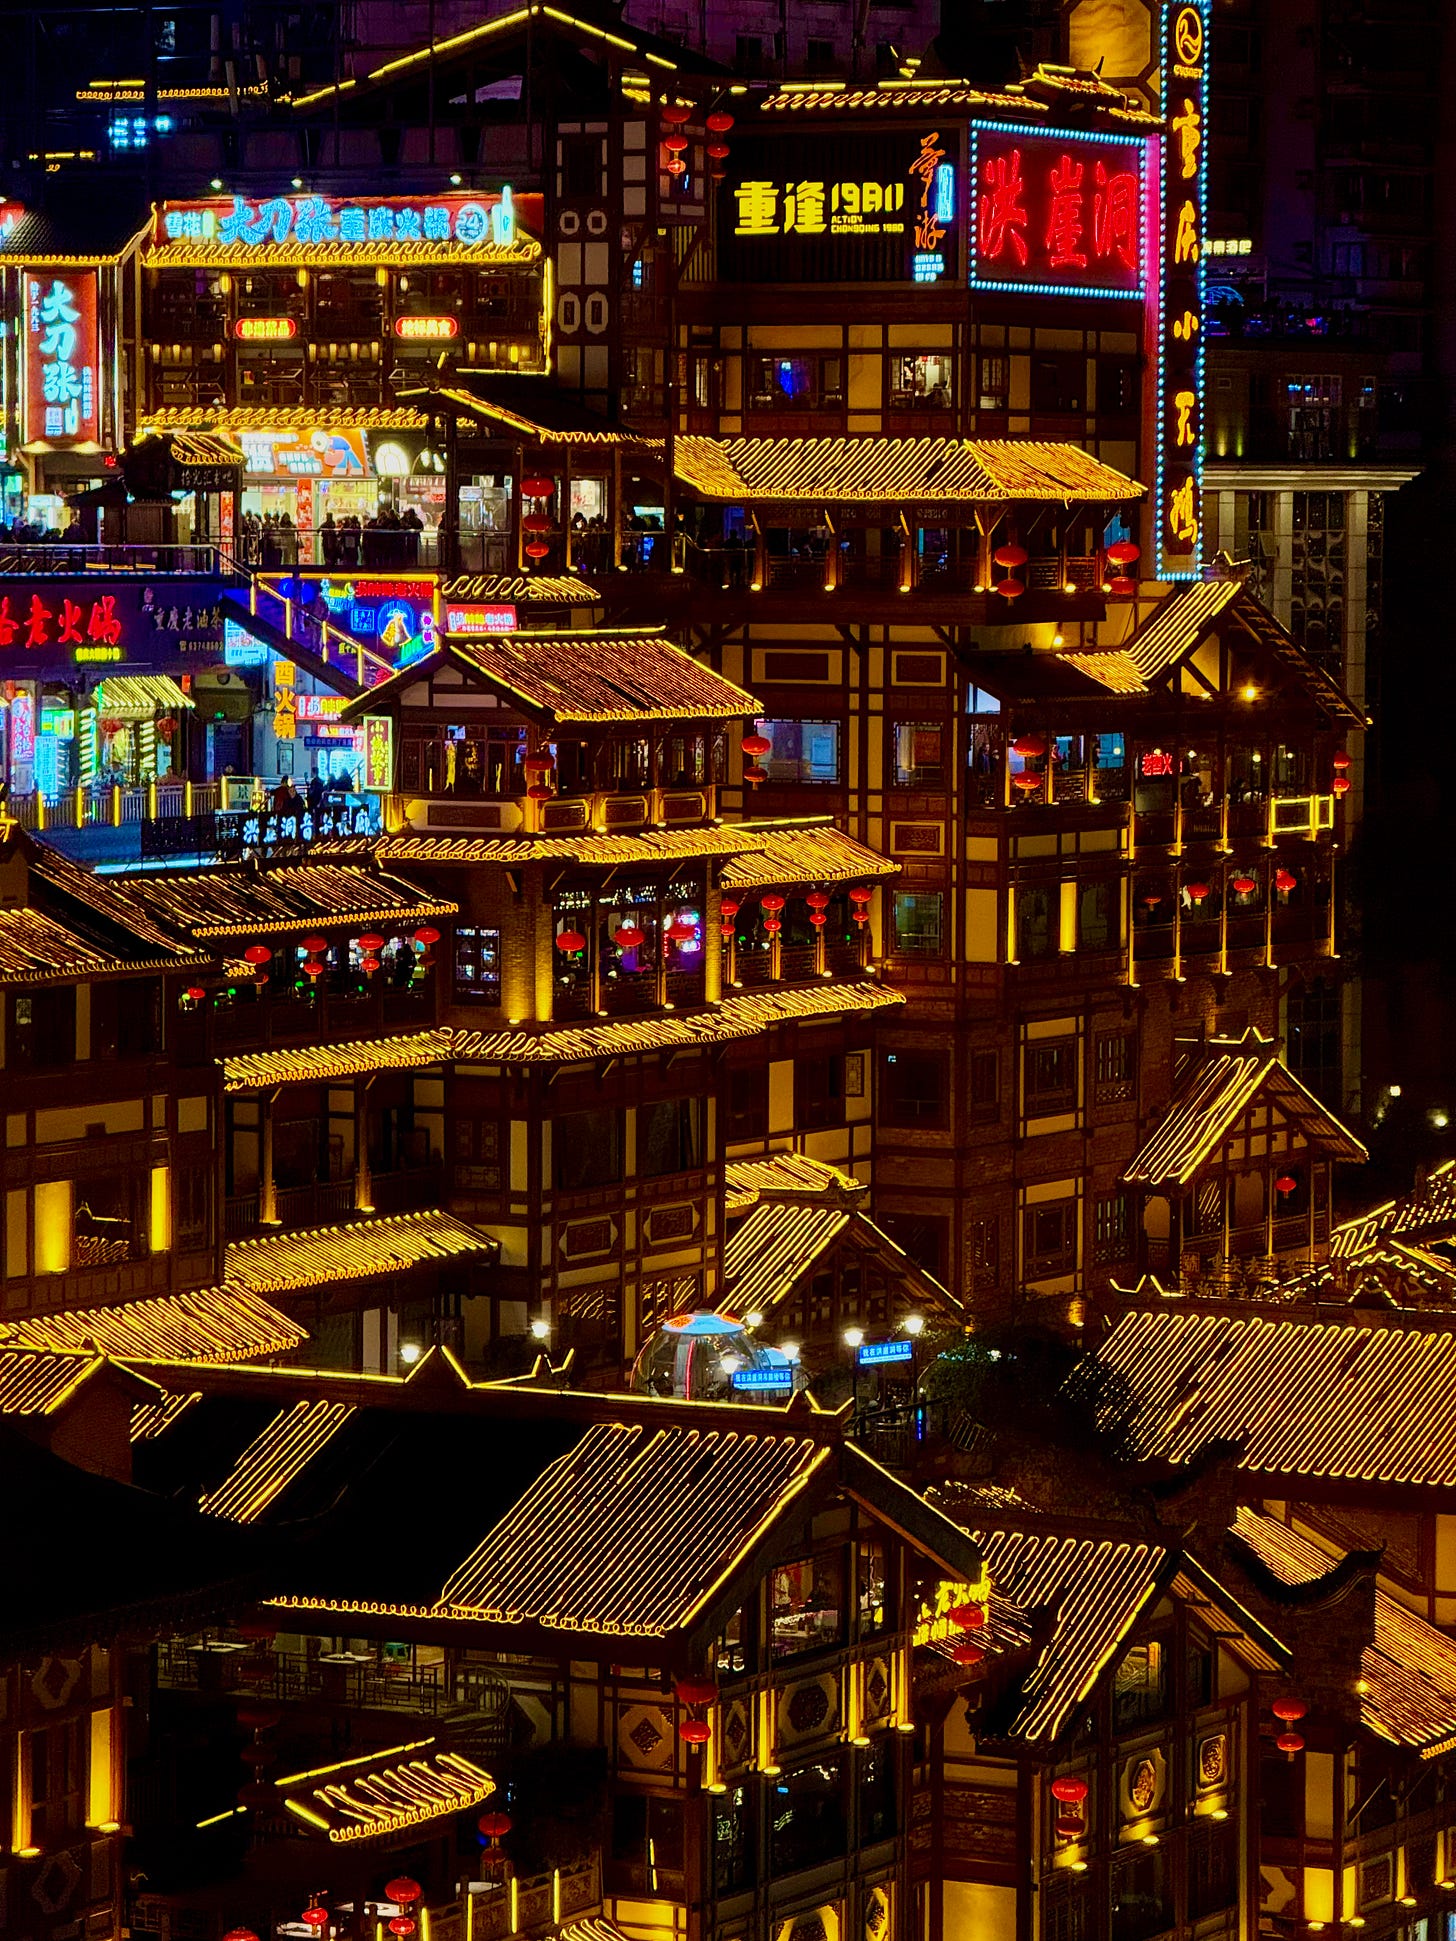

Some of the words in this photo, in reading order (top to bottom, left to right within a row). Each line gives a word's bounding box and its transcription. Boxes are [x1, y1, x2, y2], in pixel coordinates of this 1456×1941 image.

[831, 224, 880, 234] CHONGQING
[979, 148, 1138, 272] 洪崖洞
[39, 280, 82, 402] 大刀张
